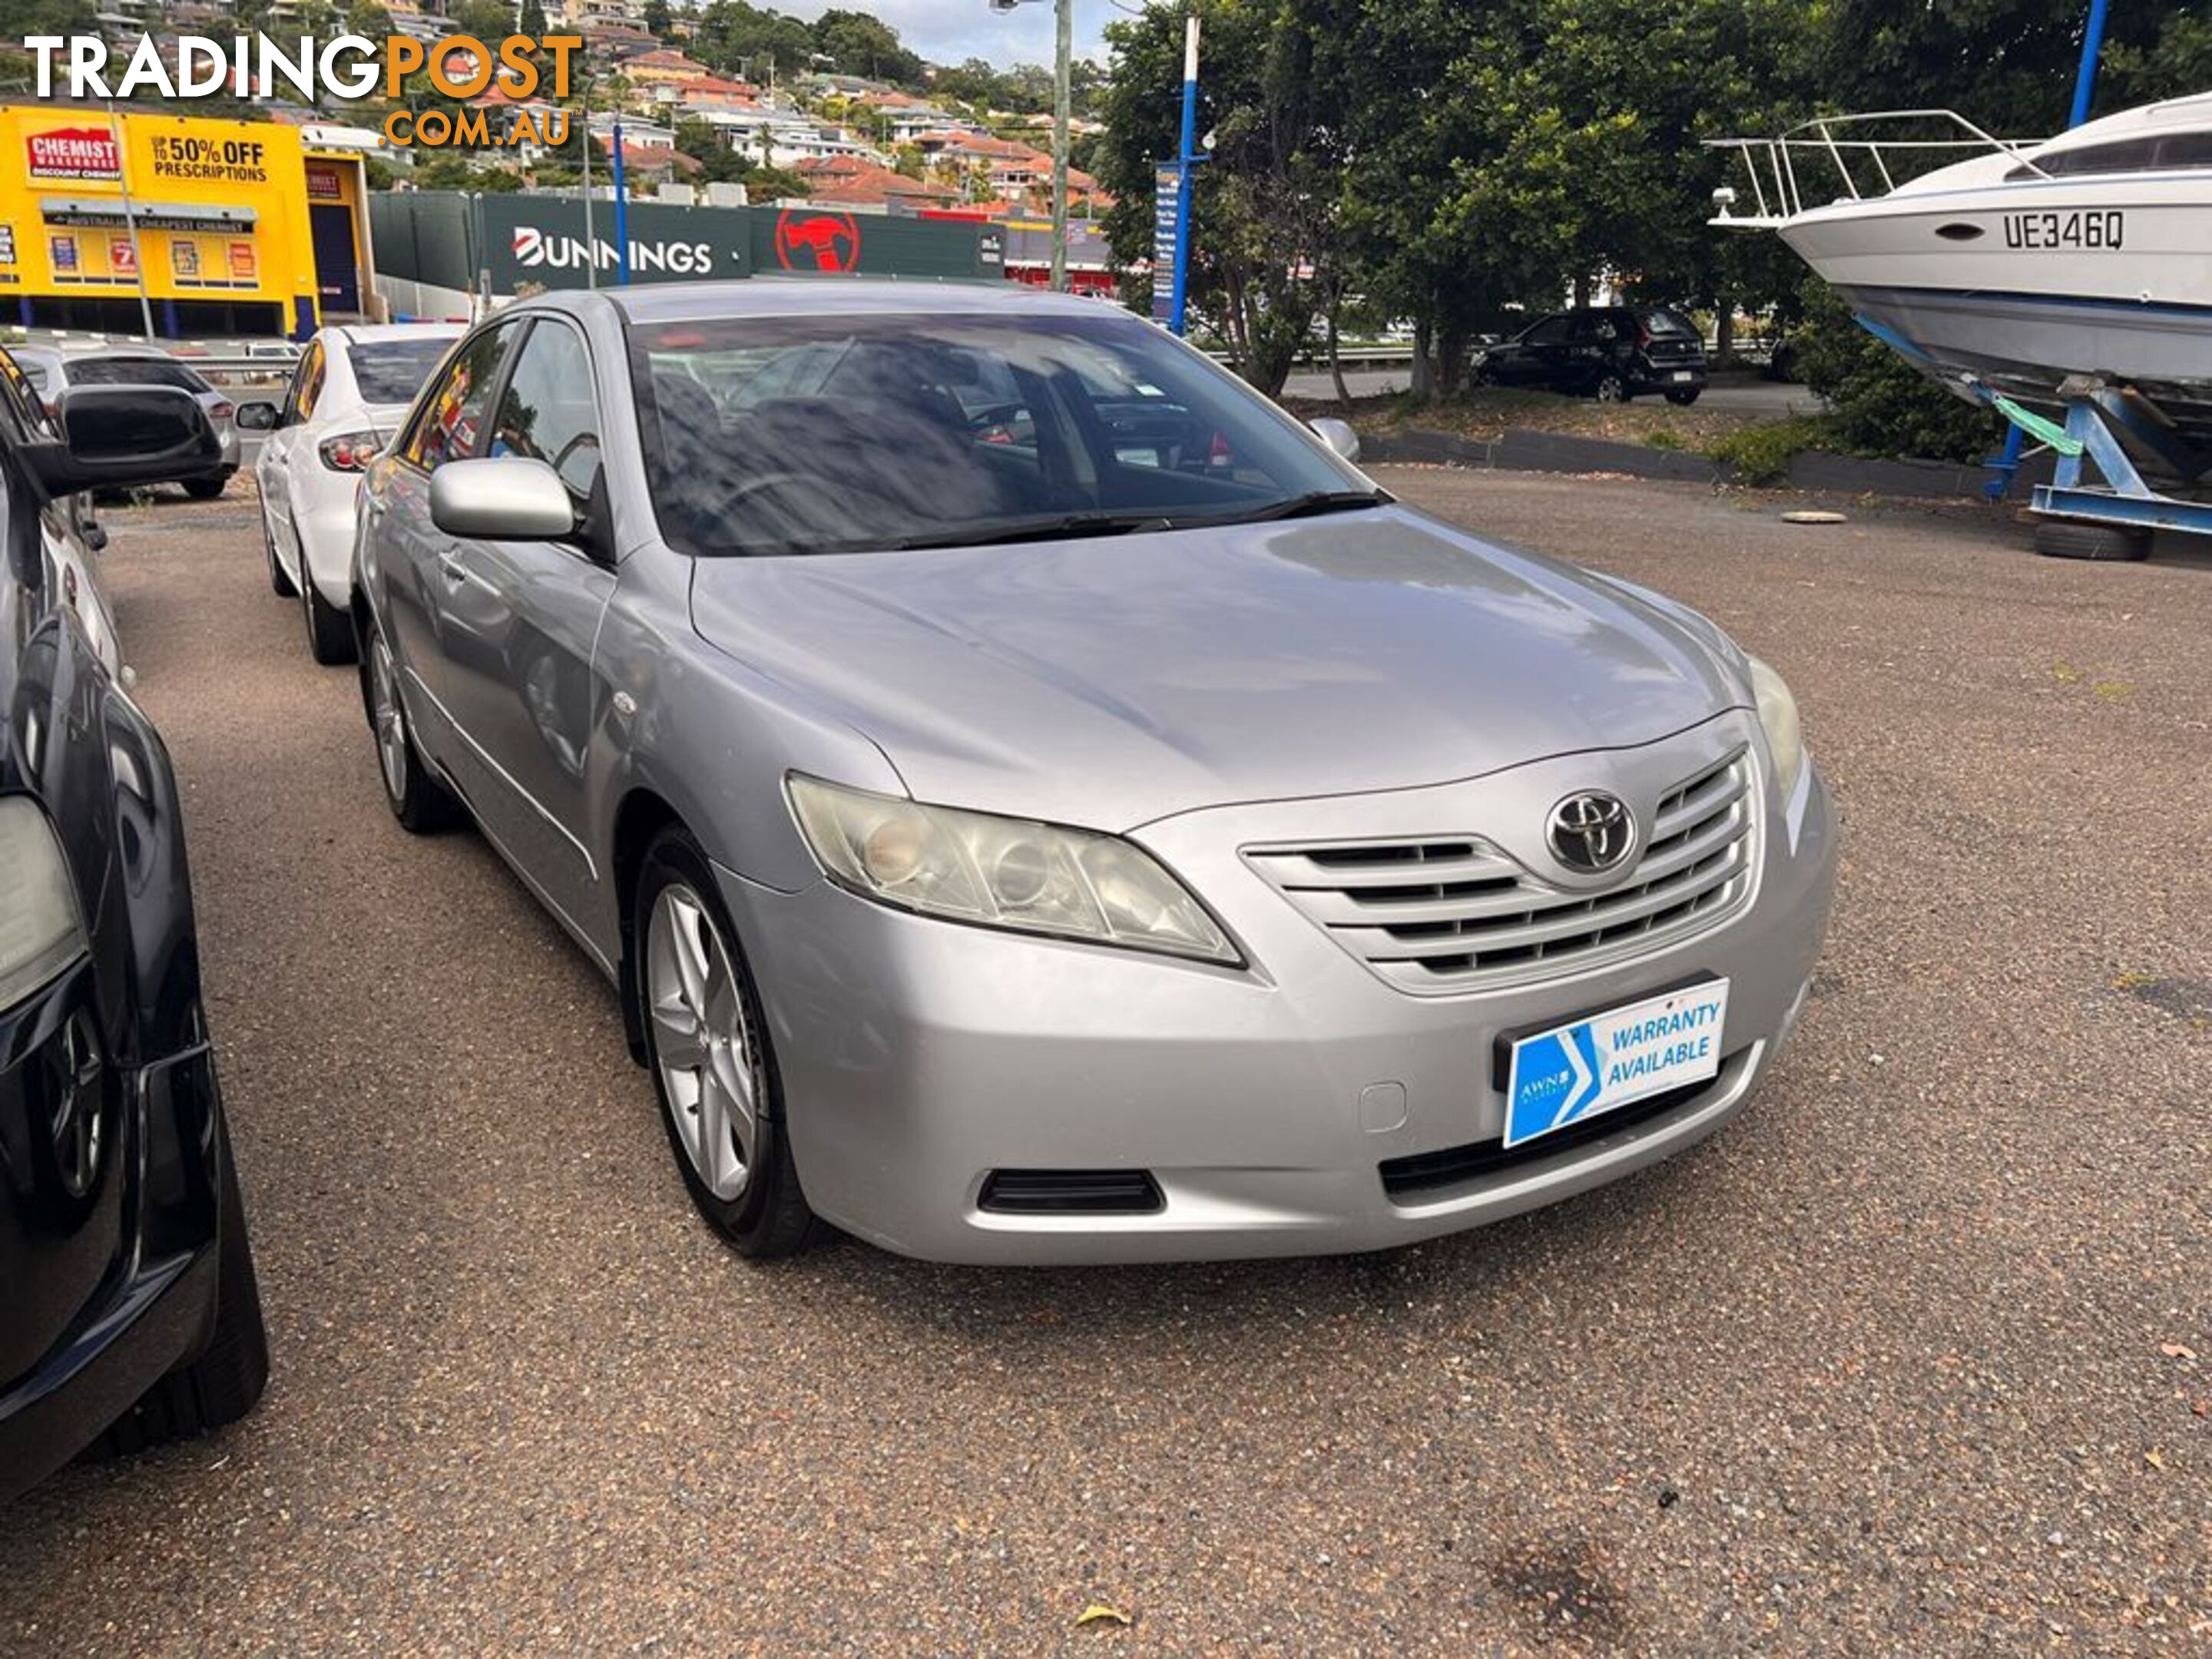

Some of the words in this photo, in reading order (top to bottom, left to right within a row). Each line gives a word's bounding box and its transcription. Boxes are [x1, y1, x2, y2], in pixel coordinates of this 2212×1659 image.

[32, 137, 114, 158] CHEMIST
[170, 137, 221, 163] 50%
[224, 140, 263, 165] OFF
[154, 161, 267, 182] PRESCRIPTIONS
[2004, 211, 2124, 250] UE346Q
[512, 227, 713, 273] BUNNINGS
[1613, 1002, 1720, 1051] WARRANTY
[1608, 1036, 1710, 1086] AVAILABLE
[1521, 1072, 1559, 1097] AWN
